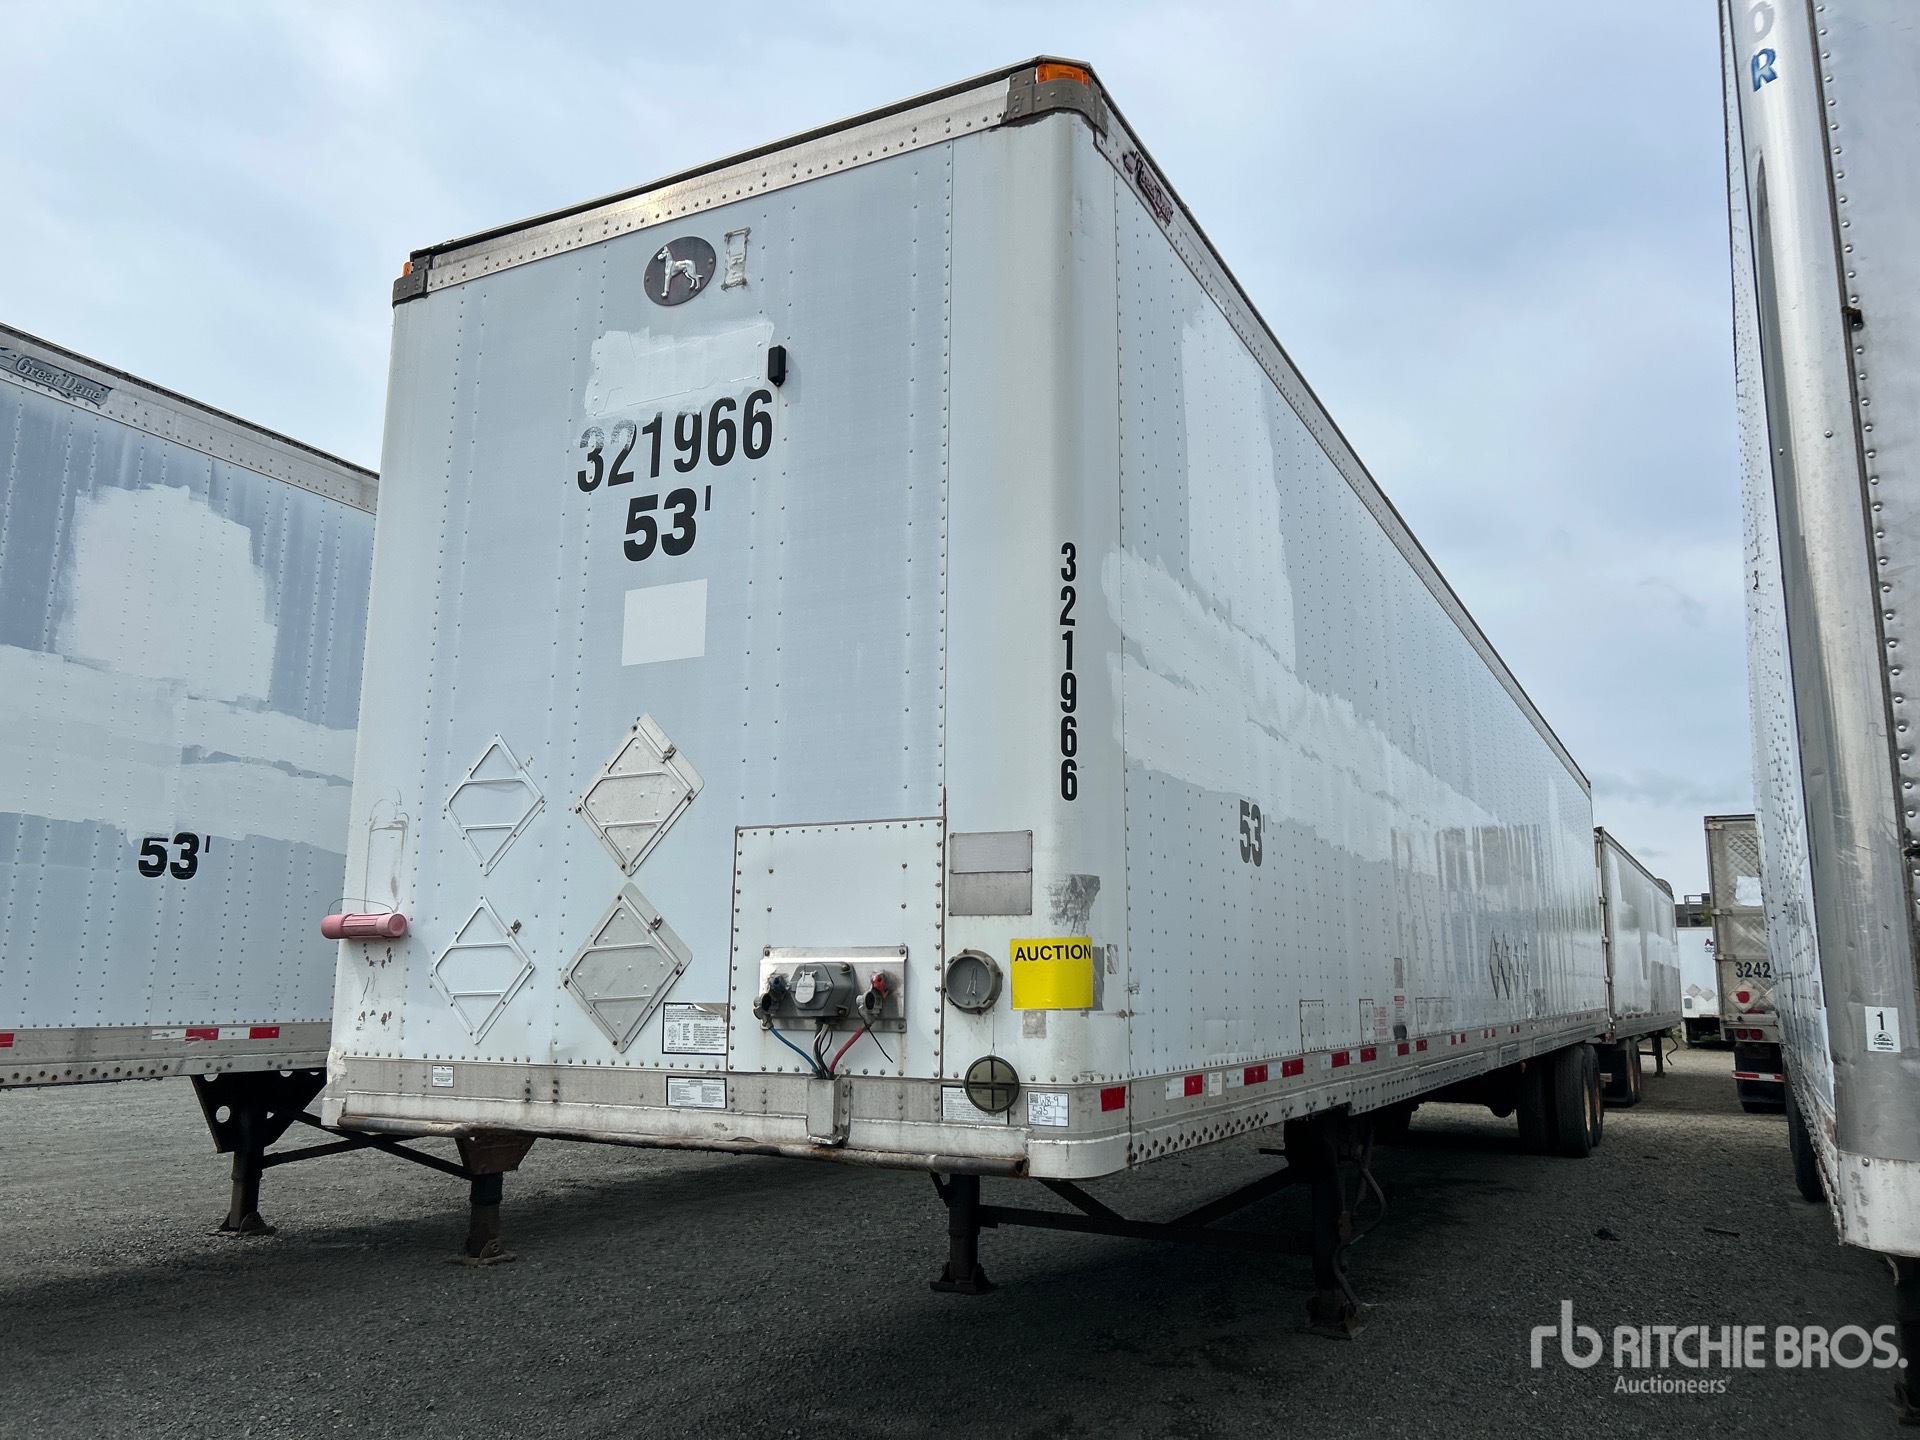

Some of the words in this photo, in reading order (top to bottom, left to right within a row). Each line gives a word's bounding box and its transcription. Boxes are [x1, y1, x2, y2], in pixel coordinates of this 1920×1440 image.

[16, 356, 61, 387] Great
[61, 373, 102, 400] Dane
[577, 389, 773, 493] 321966
[623, 485, 712, 562] 53'
[1059, 541, 1078, 802] 321966
[138, 831, 211, 880] 53'
[1014, 944, 1092, 962] AUCTION
[1735, 961, 1772, 979] 3242
[1876, 1010, 1885, 1031] 1
